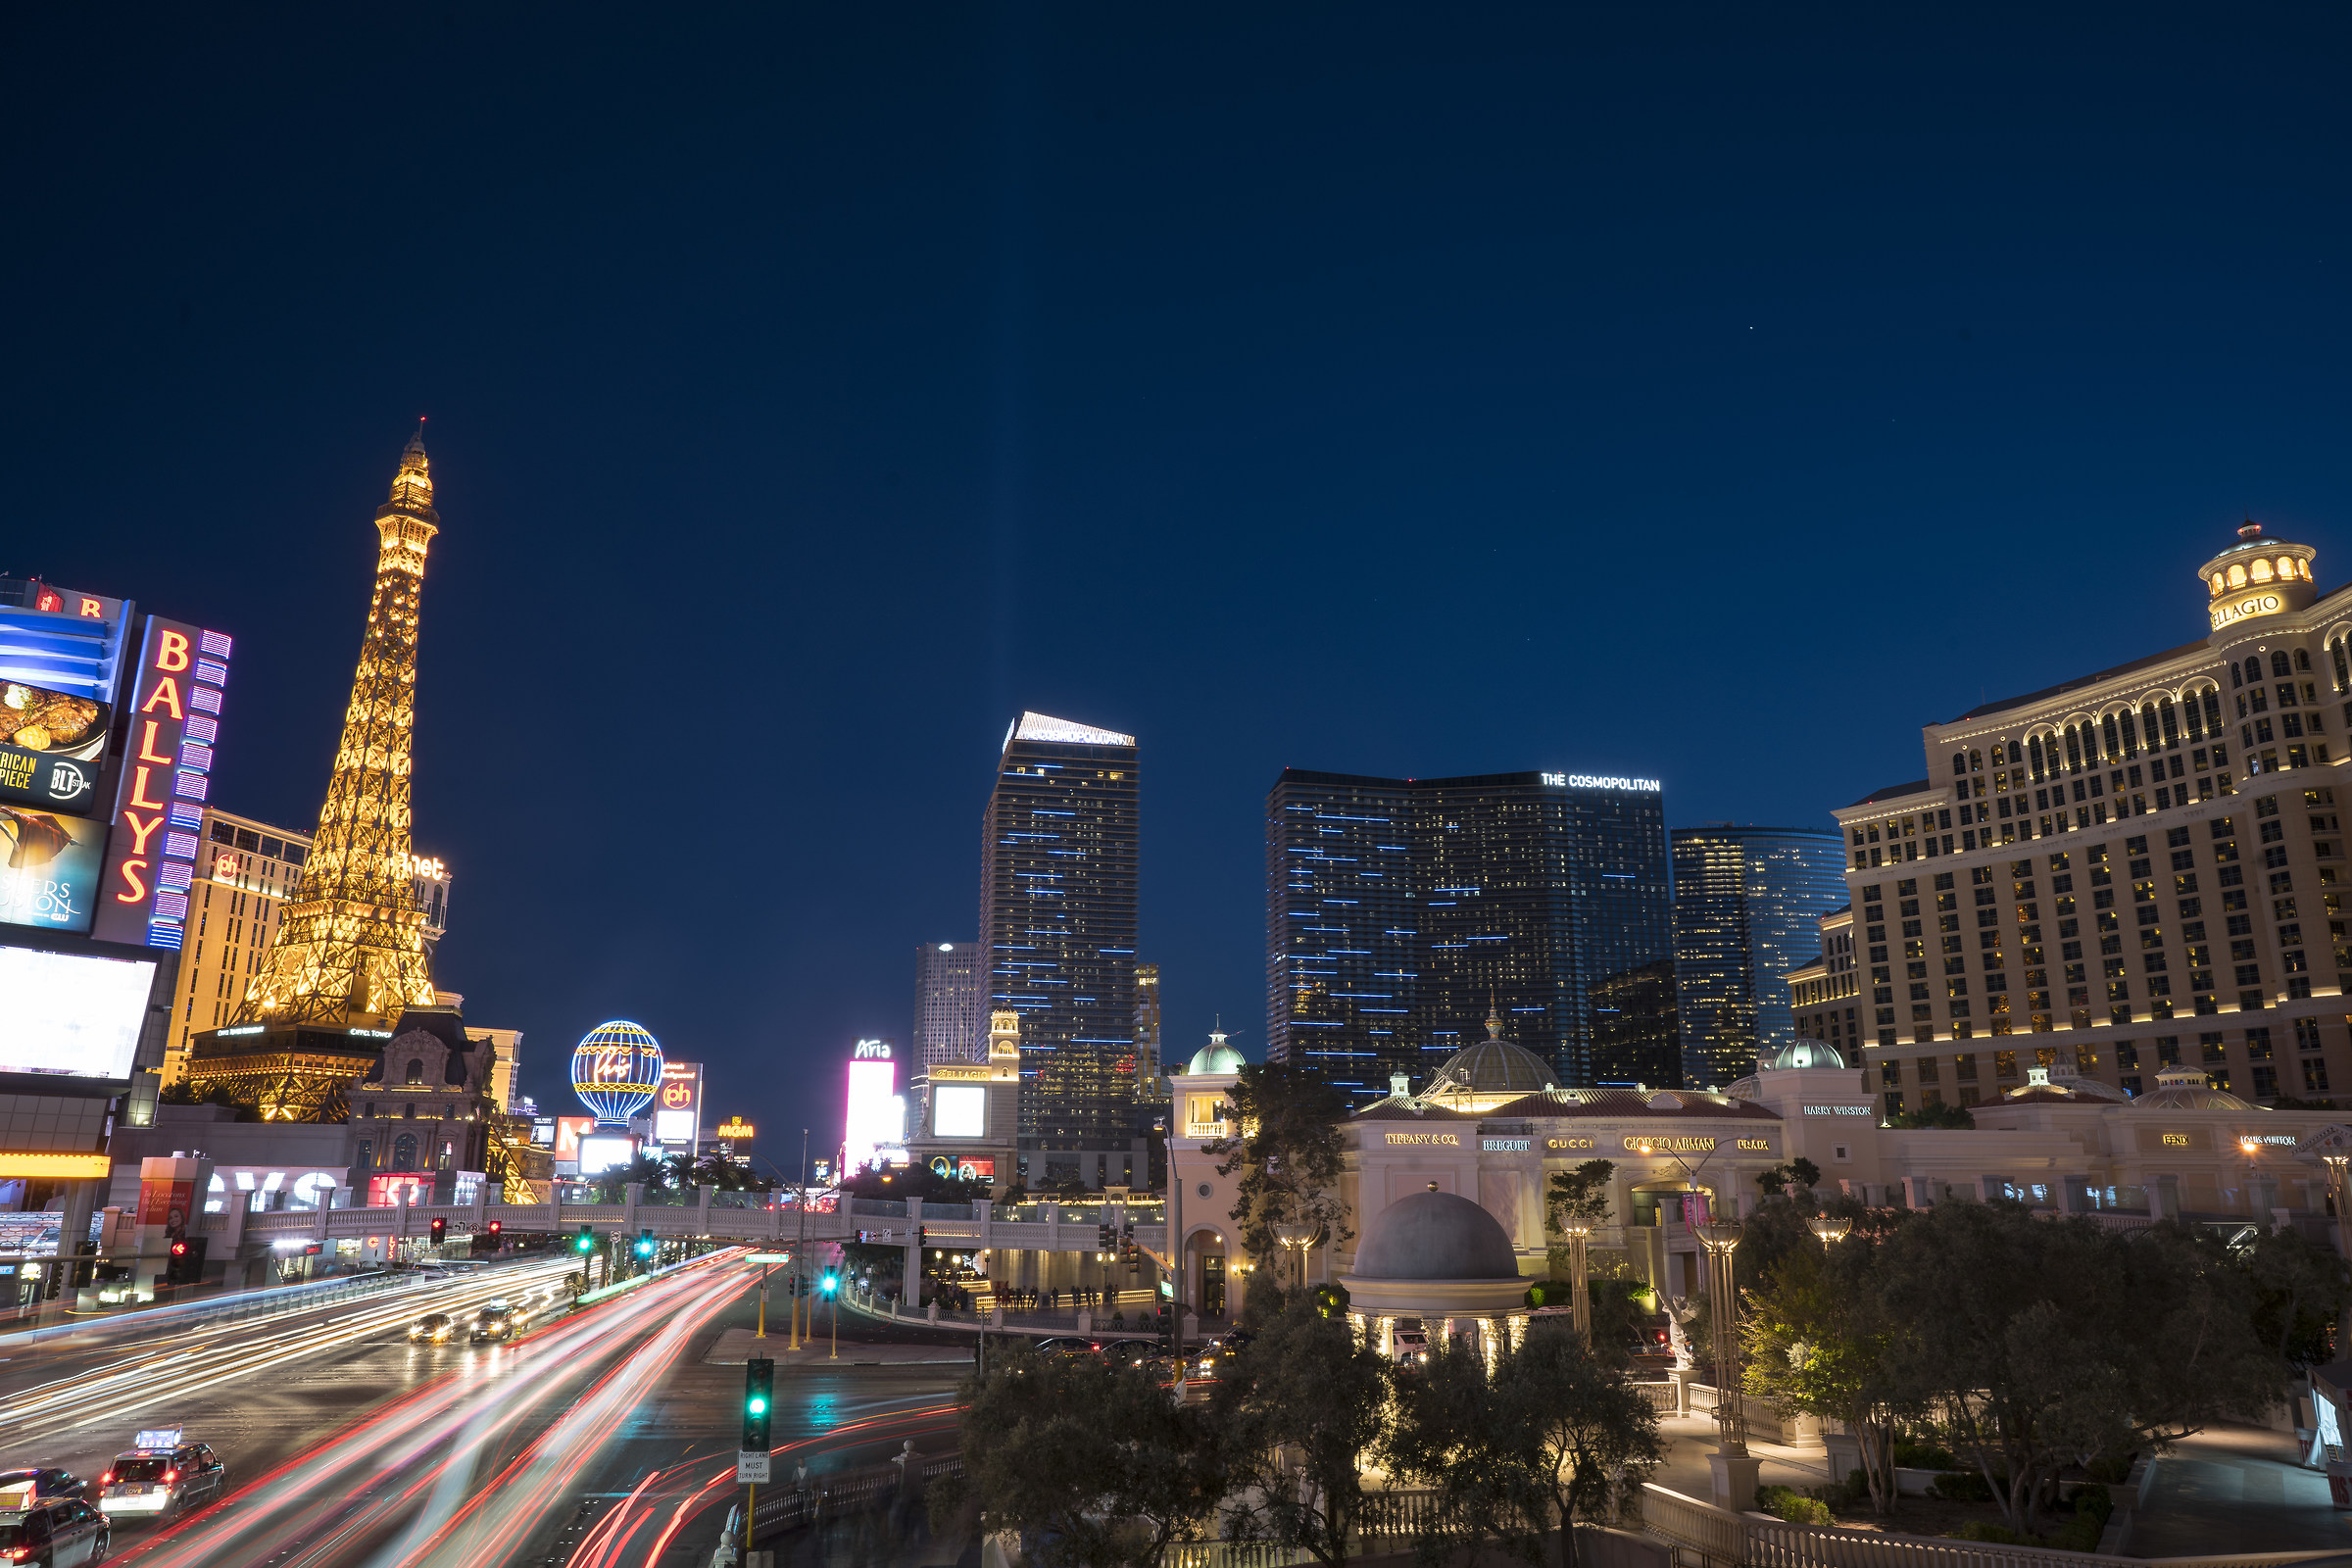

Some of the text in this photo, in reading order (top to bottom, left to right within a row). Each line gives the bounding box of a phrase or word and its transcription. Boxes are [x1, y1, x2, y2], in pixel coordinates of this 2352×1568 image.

[81, 598, 101, 618] R
[2211, 595, 2278, 628] ELLAGIO
[0, 752, 37, 774] RICAN
[50, 768, 91, 793] BLT STAK
[1541, 772, 1660, 792] THE COSMOPOLITAN
[217, 854, 237, 879] ph
[936, 1068, 988, 1080] BELLAGIO
[663, 1082, 692, 1109] ph
[1803, 1105, 1871, 1116] HARRY WINSTON
[718, 1125, 754, 1138] MGM
[1385, 1134, 1431, 1145] TIFFANY
[1432, 1134, 1441, 1145] &
[1483, 1140, 1531, 1152] BREGUET
[1547, 1139, 1593, 1149] GUCCI
[1624, 1137, 1672, 1151] GIORGIO
[1738, 1139, 1769, 1151] PRADA
[2163, 1134, 2189, 1145] FENDI
